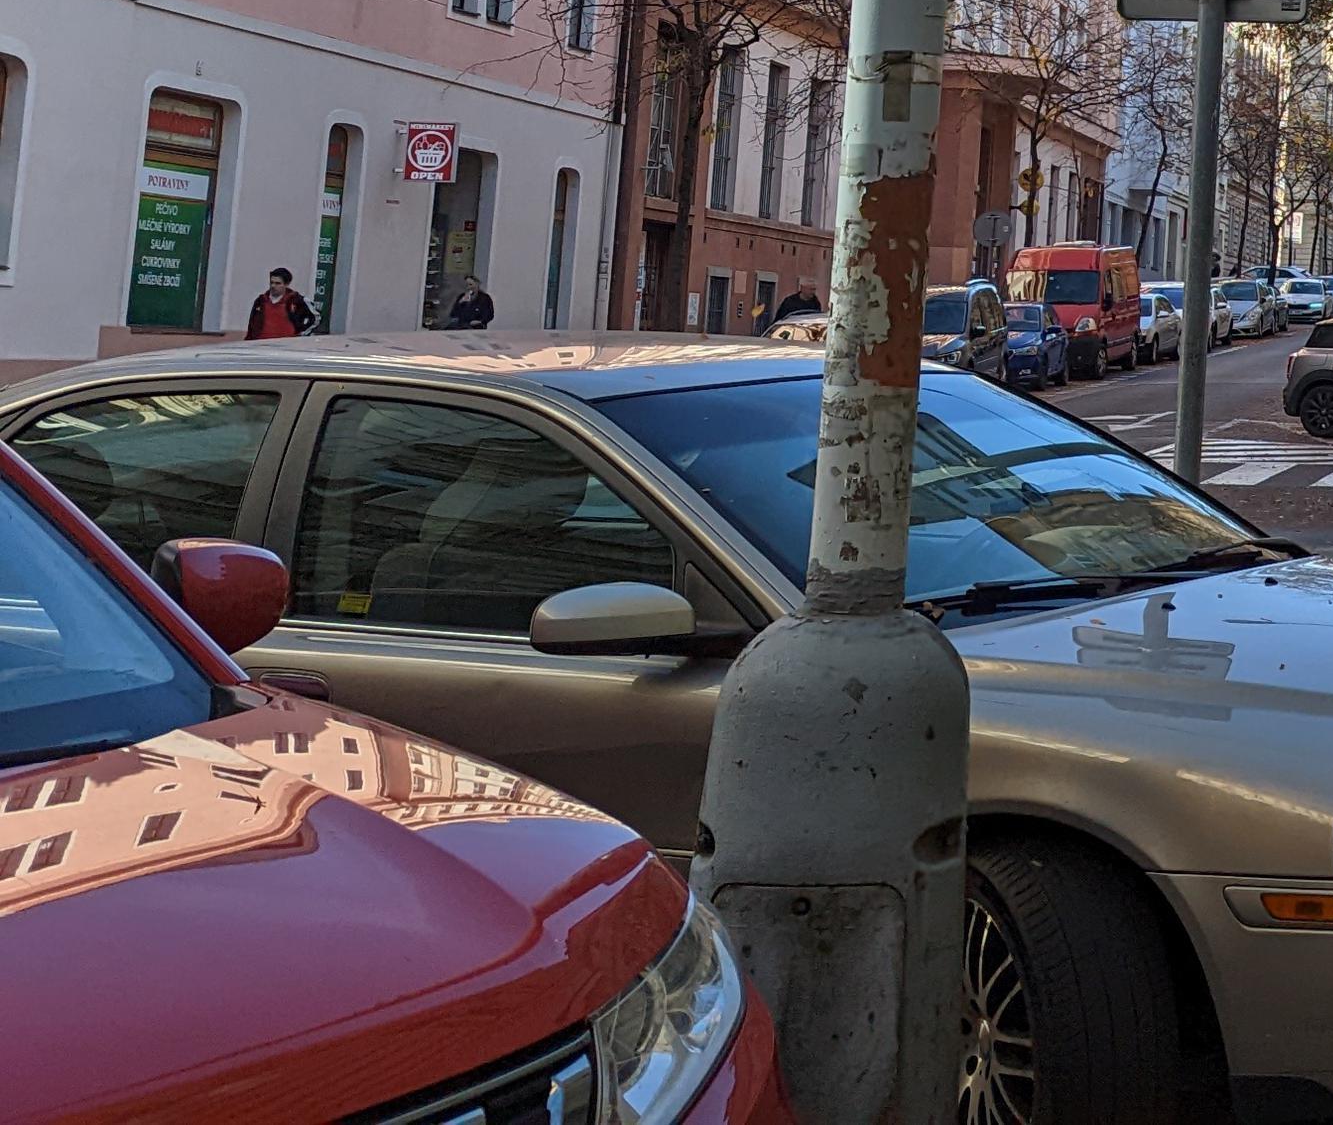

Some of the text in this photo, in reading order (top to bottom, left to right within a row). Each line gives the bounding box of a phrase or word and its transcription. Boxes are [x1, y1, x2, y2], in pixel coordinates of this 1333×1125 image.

[147, 175, 191, 191] POTRAVINY
[410, 172, 444, 181] OPEN
[155, 201, 178, 216] PEČIVO
